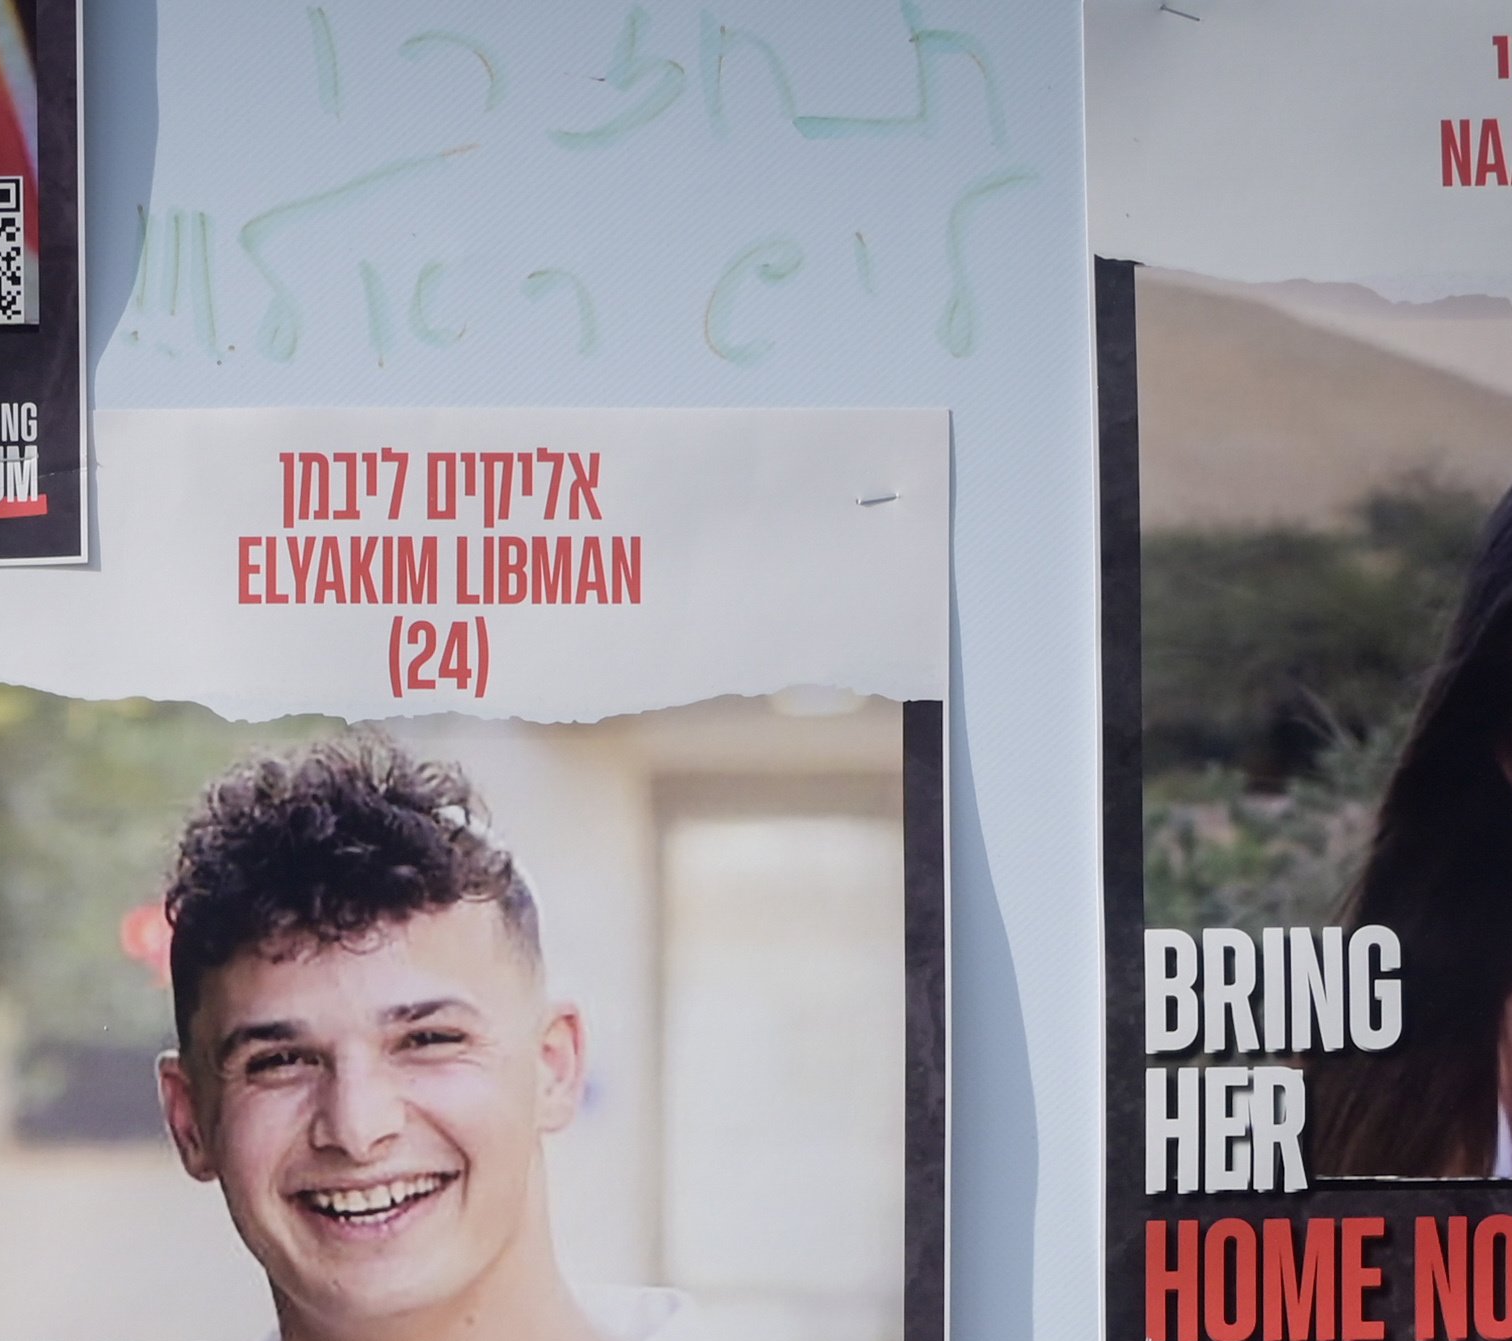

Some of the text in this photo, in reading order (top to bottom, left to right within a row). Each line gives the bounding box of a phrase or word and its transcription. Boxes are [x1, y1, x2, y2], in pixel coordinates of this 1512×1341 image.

[280, 448, 602, 528] אליקים ליבמן
[240, 536, 641, 605] ELYAKIM LIBMAN
[390, 616, 490, 698] (24)
[1144, 925, 1402, 1054] BRING
[1146, 1066, 1307, 1194] HER
